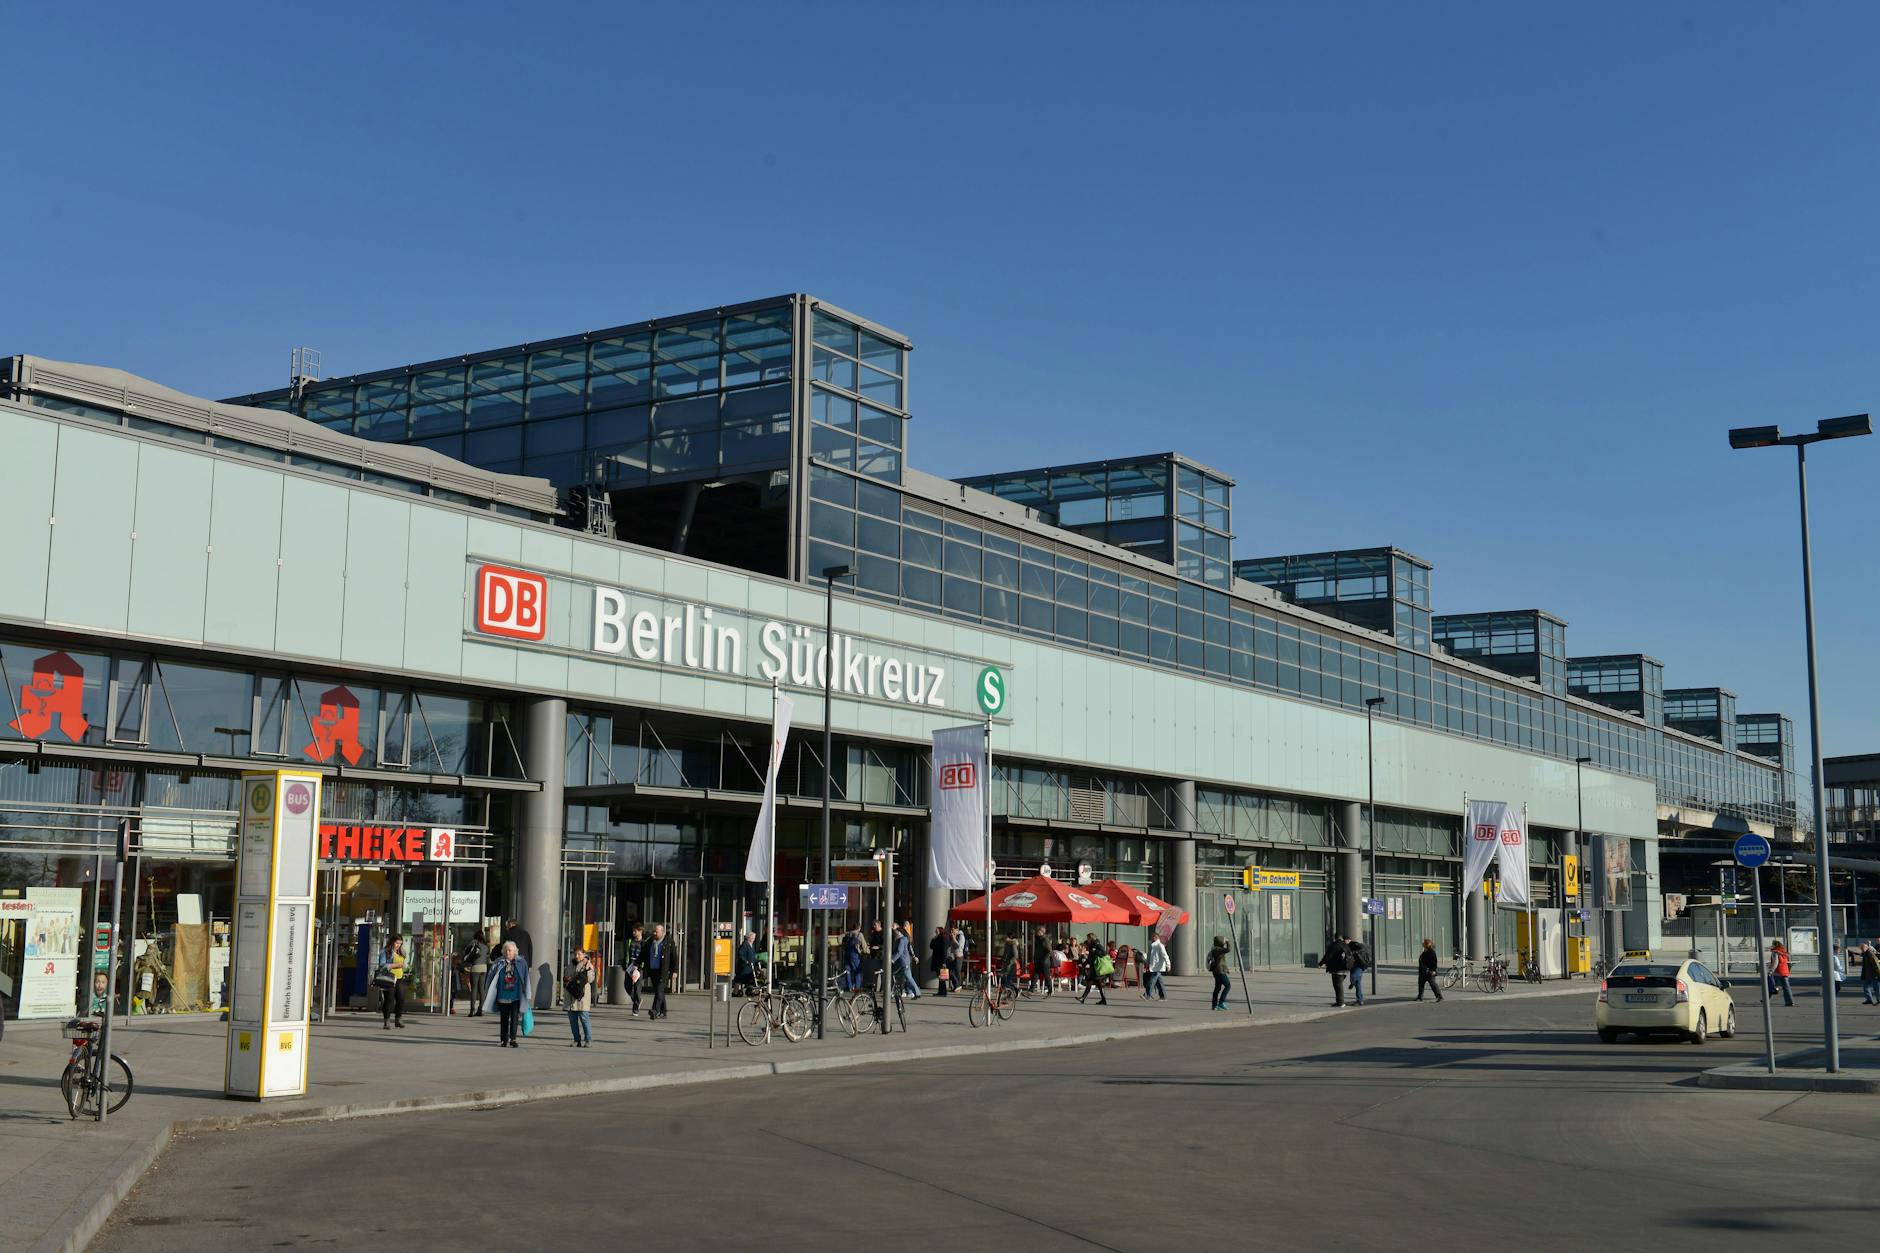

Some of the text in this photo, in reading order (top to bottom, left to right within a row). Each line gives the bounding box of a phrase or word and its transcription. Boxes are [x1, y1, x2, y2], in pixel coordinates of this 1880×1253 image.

[488, 575, 538, 628] DB
[593, 585, 945, 707] Berlin Südkreuz
[983, 671, 1000, 710] S
[287, 793, 309, 805] BUS
[1478, 827, 1494, 838] DB
[319, 825, 425, 861] THEKE
[1270, 875, 1297, 884] Bahnhof
[240, 1041, 250, 1050] BVG
[280, 1041, 292, 1050] BVG
